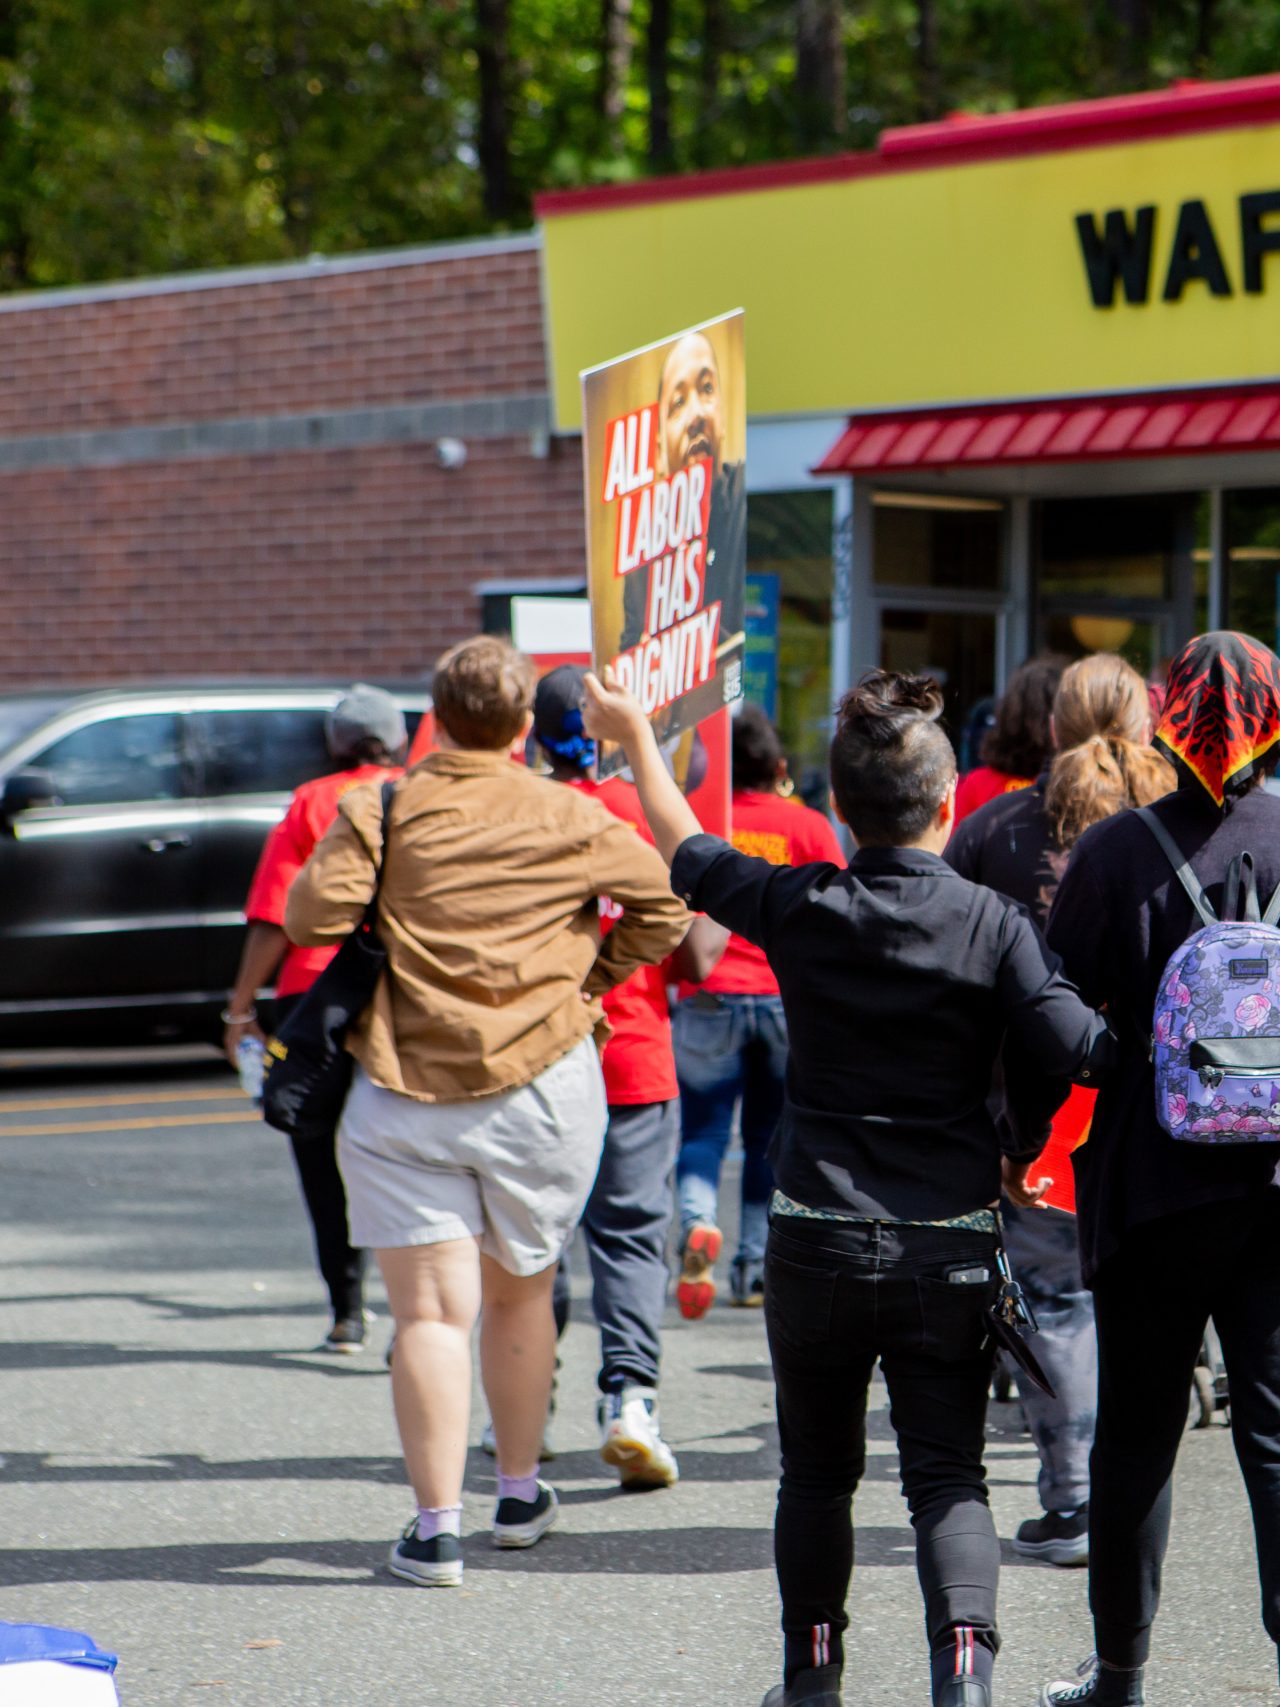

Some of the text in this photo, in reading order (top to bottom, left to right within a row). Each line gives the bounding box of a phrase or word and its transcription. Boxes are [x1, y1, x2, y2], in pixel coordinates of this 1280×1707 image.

[604, 409, 654, 501] ALL
[618, 463, 706, 574] LABOR
[650, 540, 703, 636] HAS
